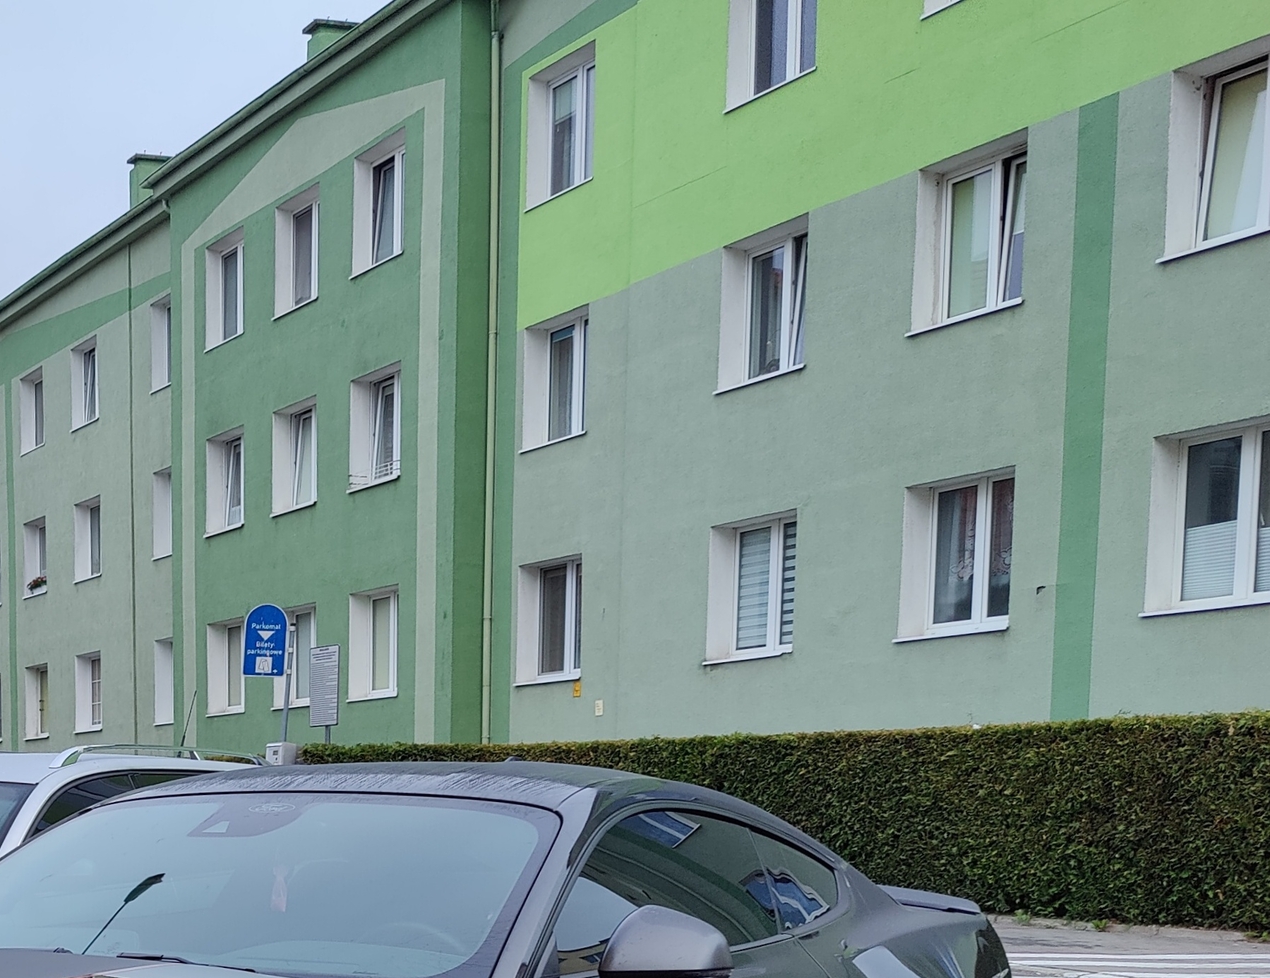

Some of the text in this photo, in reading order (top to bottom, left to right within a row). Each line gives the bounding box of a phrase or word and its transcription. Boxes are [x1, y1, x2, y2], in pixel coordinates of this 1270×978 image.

[251, 622, 281, 630] Parkomat
[256, 641, 275, 649] Bilety
[247, 649, 283, 657] parkingowe
